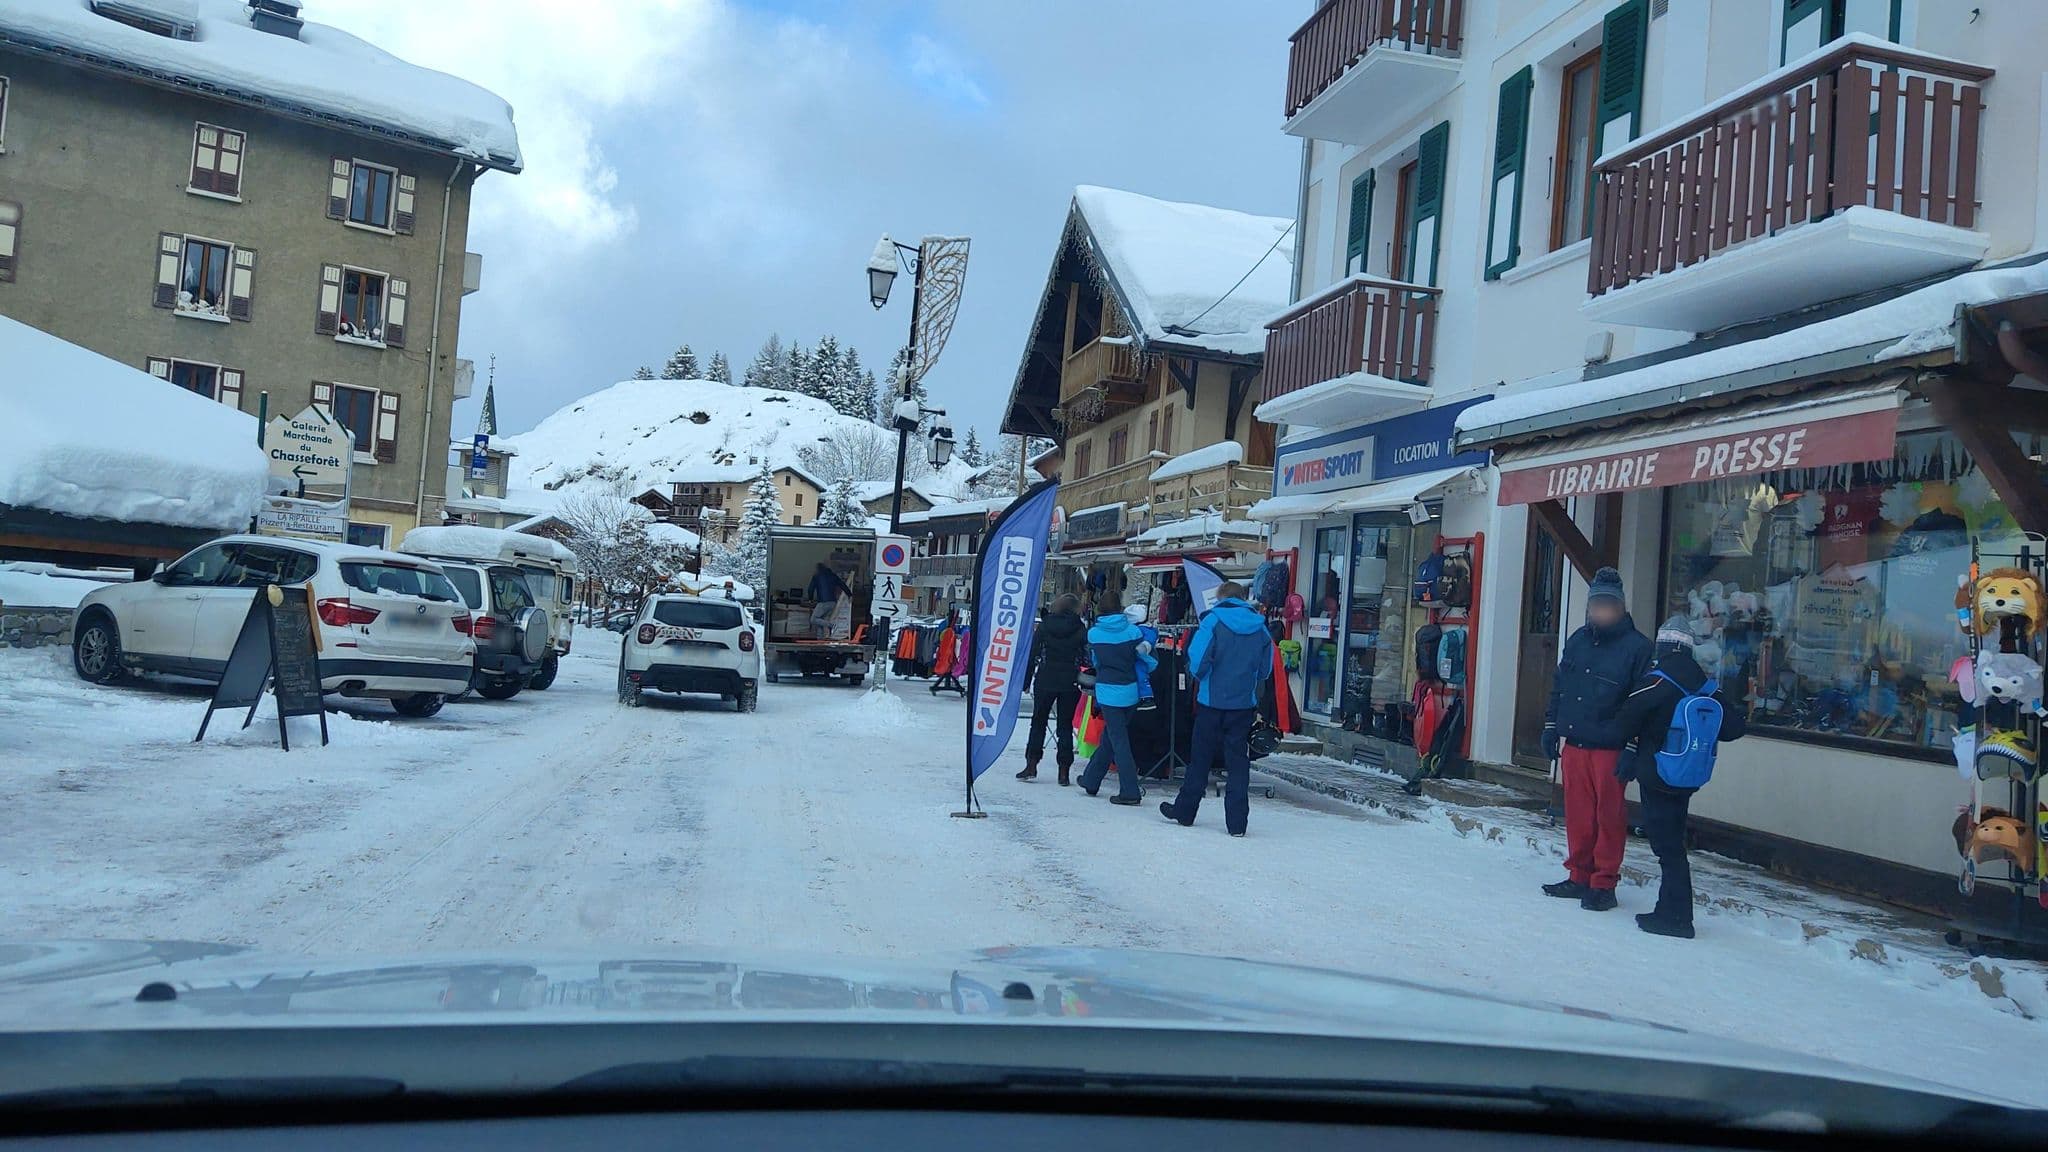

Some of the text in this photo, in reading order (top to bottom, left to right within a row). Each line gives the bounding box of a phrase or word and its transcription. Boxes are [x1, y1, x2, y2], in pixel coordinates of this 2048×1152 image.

[283, 429, 333, 444] Marchande
[291, 421, 326, 433] Galerie
[300, 443, 312, 452] du
[1394, 440, 1440, 465] LOCATION
[271, 448, 340, 467] Chasseforêt
[1546, 428, 1808, 497] LIBRAIRIE PRESSE
[1293, 450, 1365, 486] INTERSPORT
[290, 513, 320, 524] RIPAILLE
[981, 545, 1027, 706] INTERSPORT
